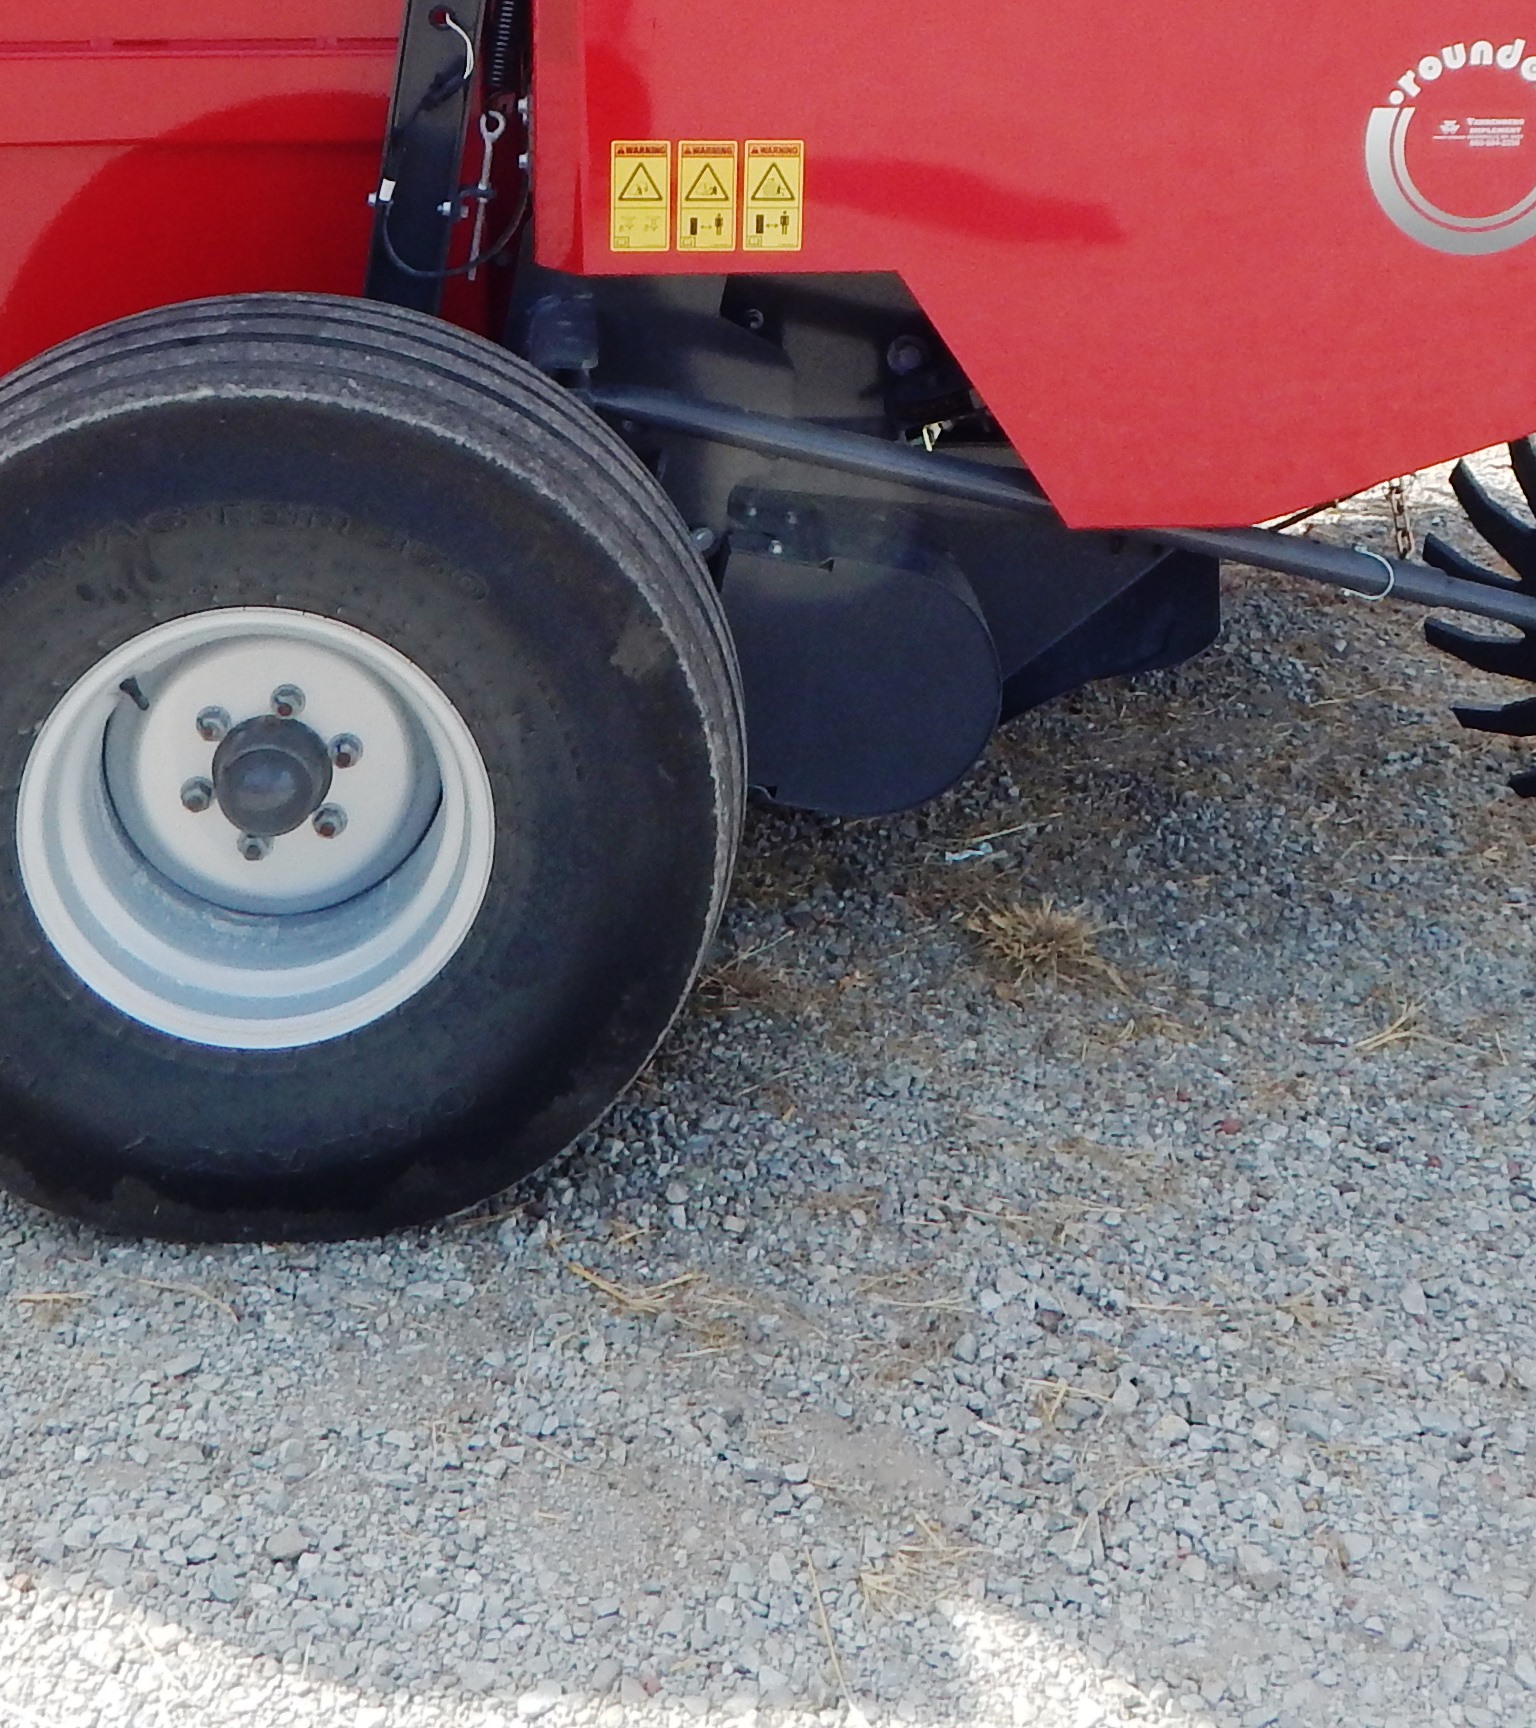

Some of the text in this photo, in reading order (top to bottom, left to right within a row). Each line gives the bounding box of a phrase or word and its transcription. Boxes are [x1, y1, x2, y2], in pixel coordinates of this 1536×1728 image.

[626, 146, 667, 155] WARNING
[692, 146, 733, 155] WARNING
[760, 146, 799, 155] WARNING
